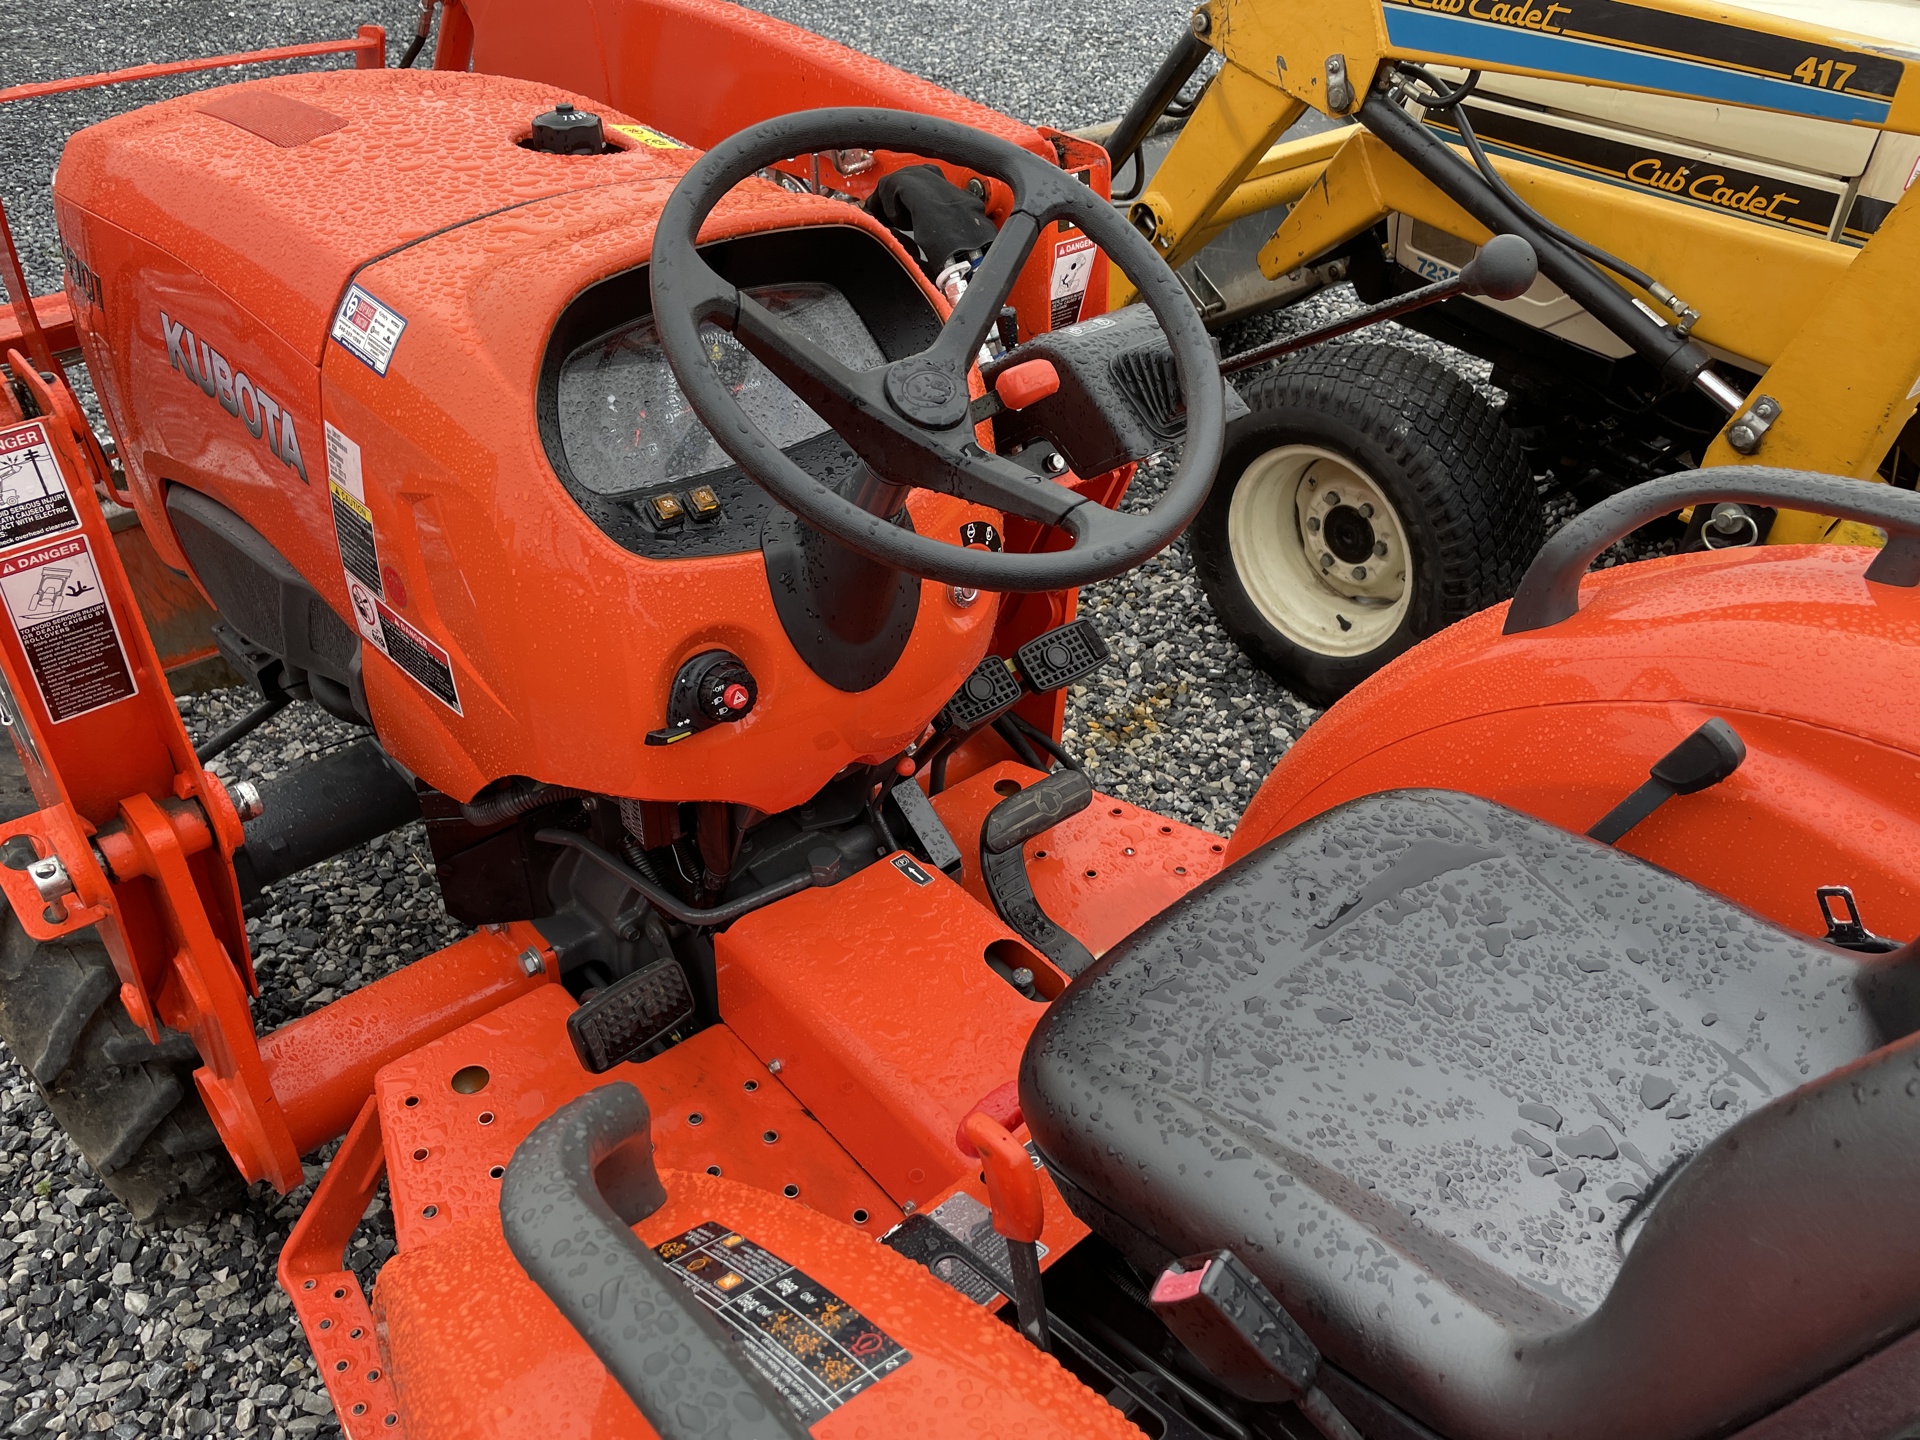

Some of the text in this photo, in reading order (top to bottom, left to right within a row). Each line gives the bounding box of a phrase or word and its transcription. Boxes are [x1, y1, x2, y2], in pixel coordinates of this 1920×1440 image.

[1468, 0, 1572, 32] Cadet
[1793, 56, 1857, 90] 417
[1627, 158, 1800, 221] Cub Cadet
[160, 311, 309, 486] KUBOTA
[10, 500, 41, 514] SERIOUS
[41, 492, 66, 506] INJURY
[15, 506, 44, 520] CAUSED
[340, 490, 366, 518] CAUTION
[0, 505, 68, 532] ACT WITH ELECTRIC
[15, 528, 44, 542] overhead
[16, 541, 80, 569] DANGER
[30, 622, 50, 631] AVOID
[52, 612, 81, 624] SERIOUS
[81, 604, 104, 614] INJURY
[35, 624, 60, 635] DEATH
[62, 613, 93, 626] CAUSED
[24, 627, 69, 644] ROLLOVERS
[399, 621, 428, 649] DANGER
[714, 684, 725, 692] OFF
[884, 1358, 900, 1370] 2
